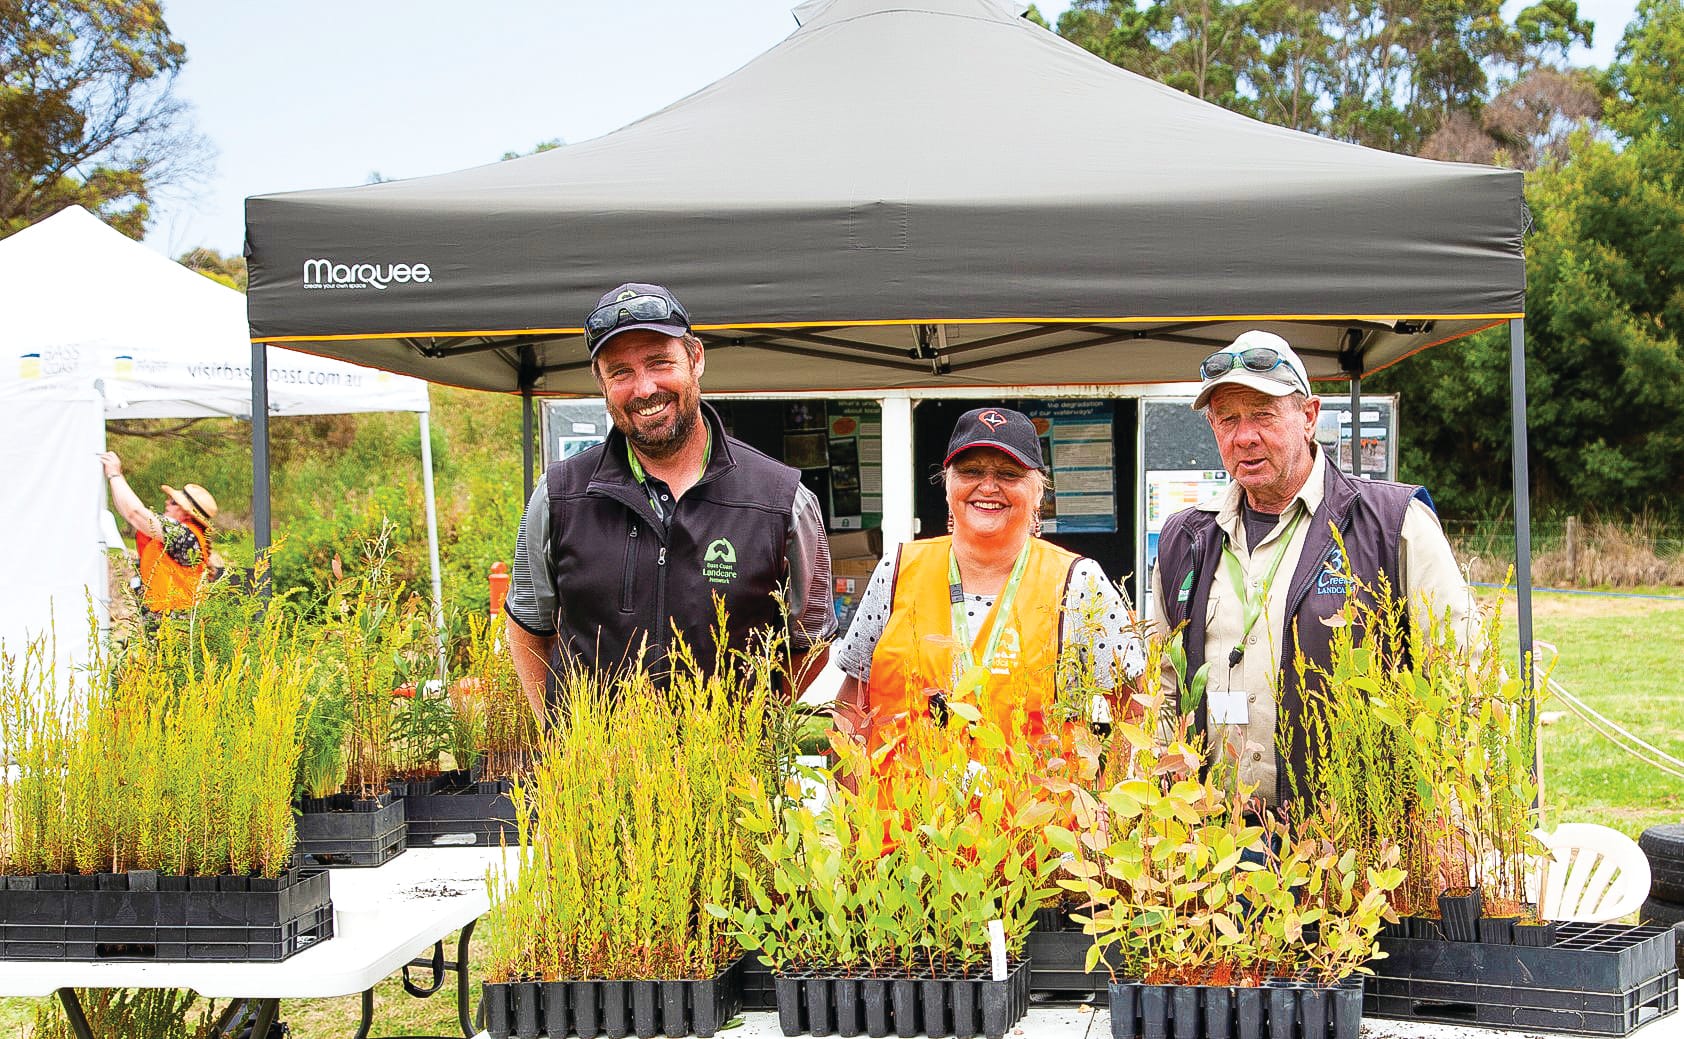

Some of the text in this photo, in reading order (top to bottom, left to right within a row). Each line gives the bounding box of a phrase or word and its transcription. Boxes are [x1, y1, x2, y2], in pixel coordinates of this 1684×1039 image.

[187, 361, 362, 387] visitbasoast.comau
[1061, 401, 1103, 409] degradation
[1331, 549, 1342, 571] 3
[702, 568, 737, 578] Landcare
[1317, 586, 1355, 595] LANDCAE
